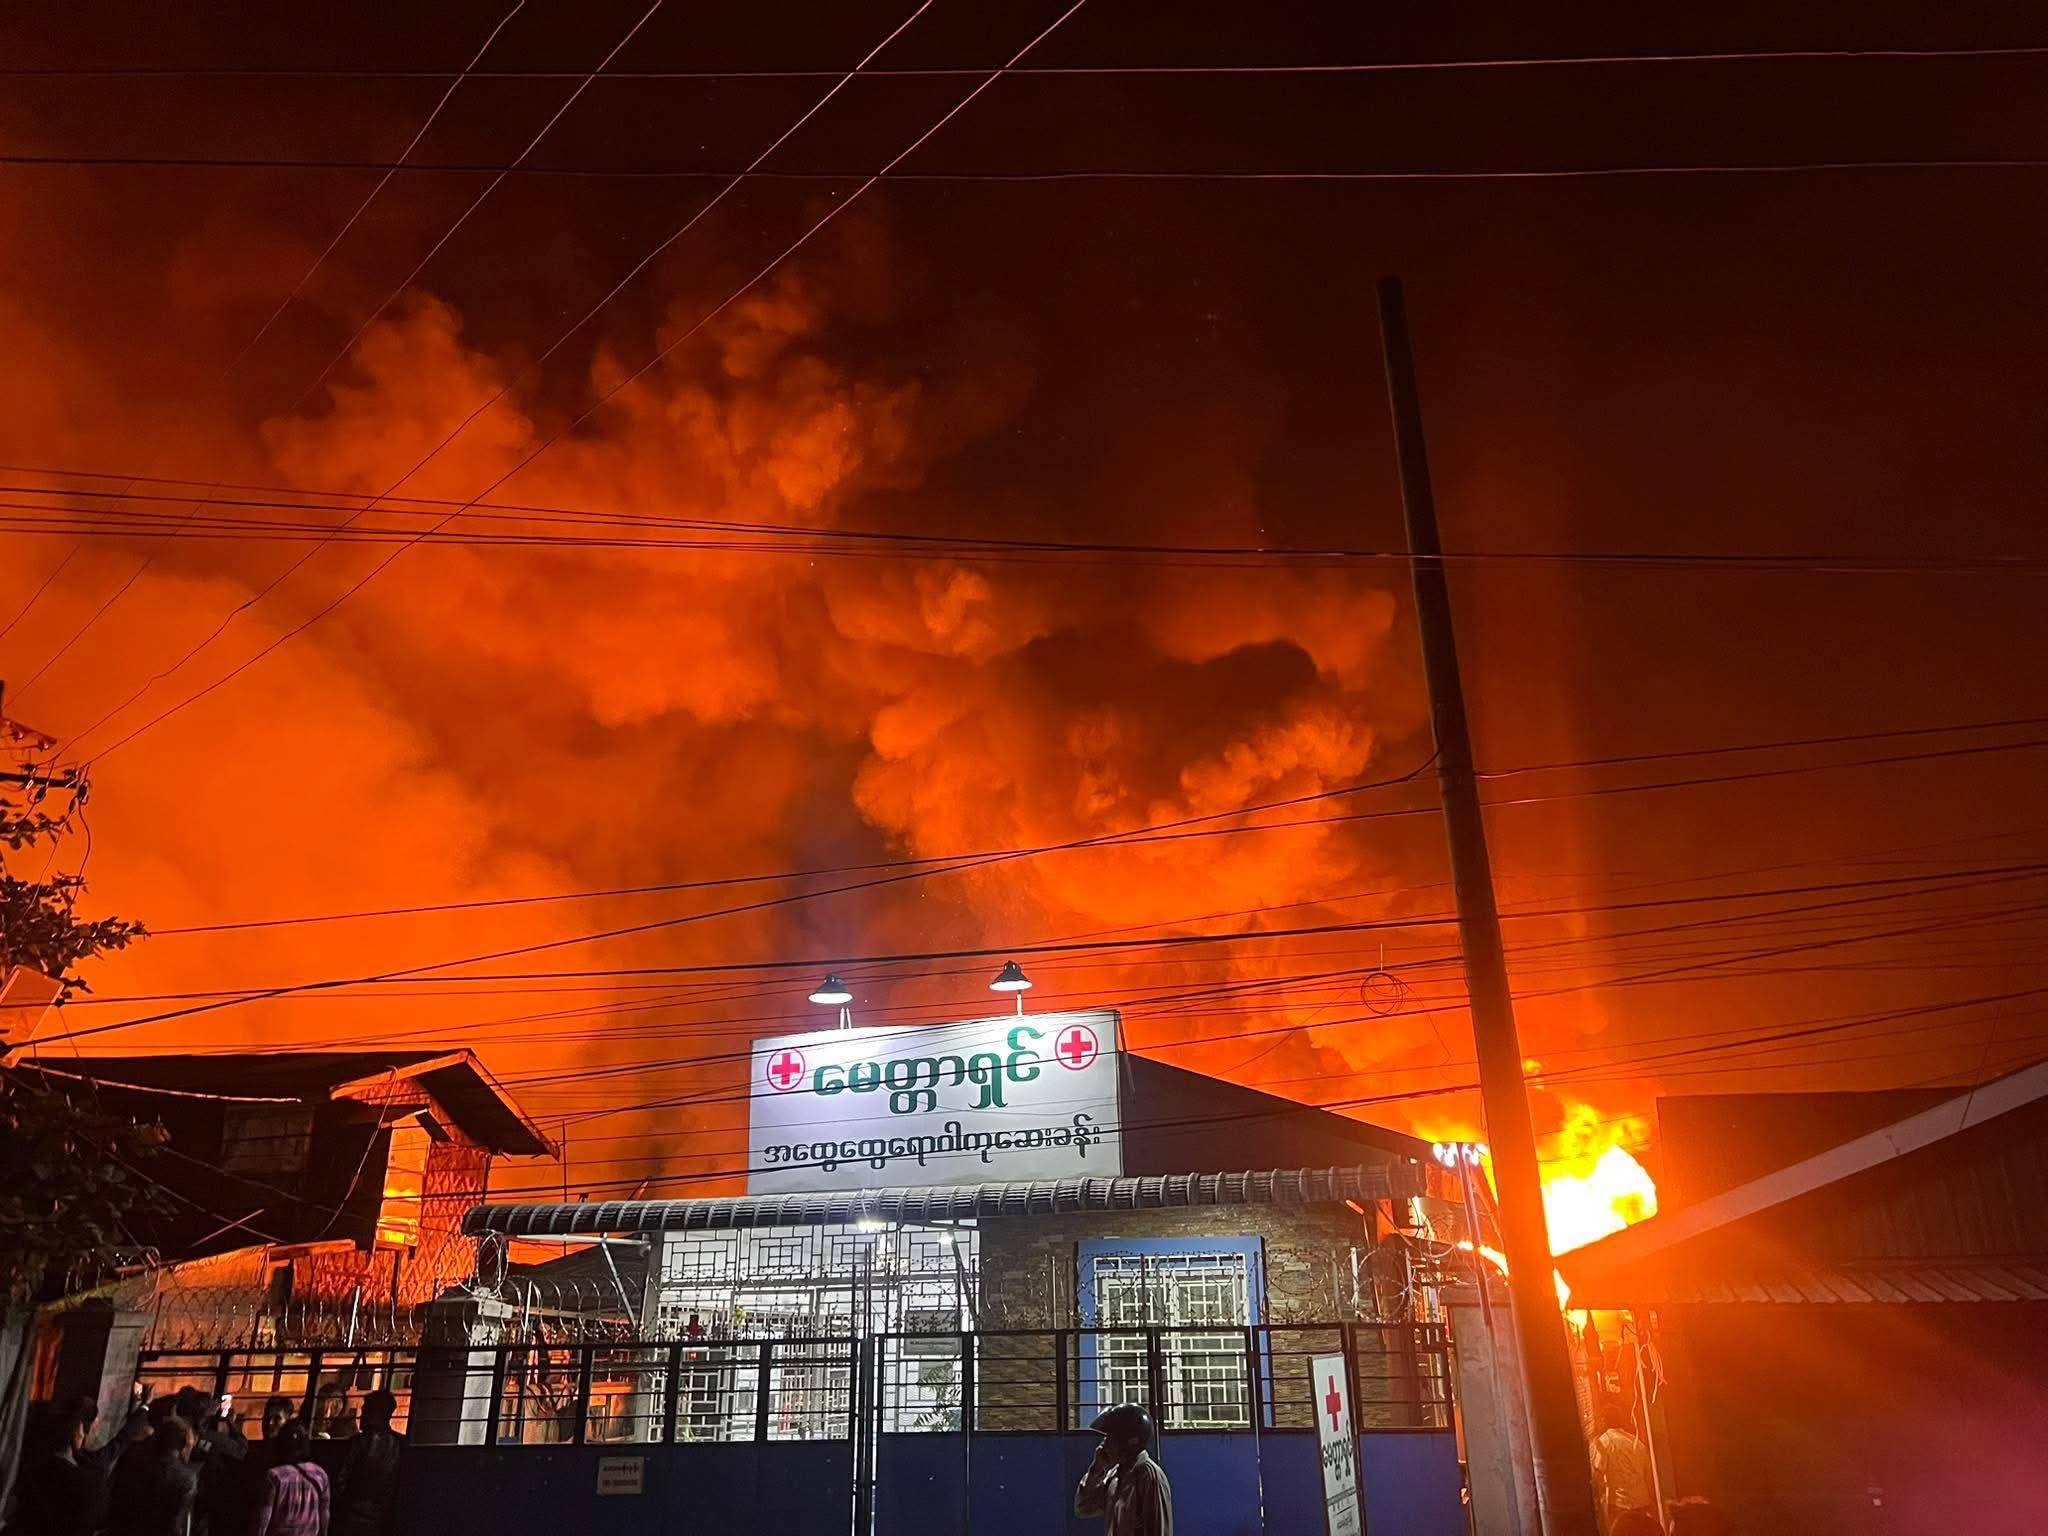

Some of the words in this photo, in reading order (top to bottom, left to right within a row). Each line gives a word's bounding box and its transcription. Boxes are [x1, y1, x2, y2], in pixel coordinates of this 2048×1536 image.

[812, 1026, 1046, 1114] မေတ္တာရှင်
[764, 1113, 1101, 1172] အထွေထွေရောဂါကုဆေးခန်း
